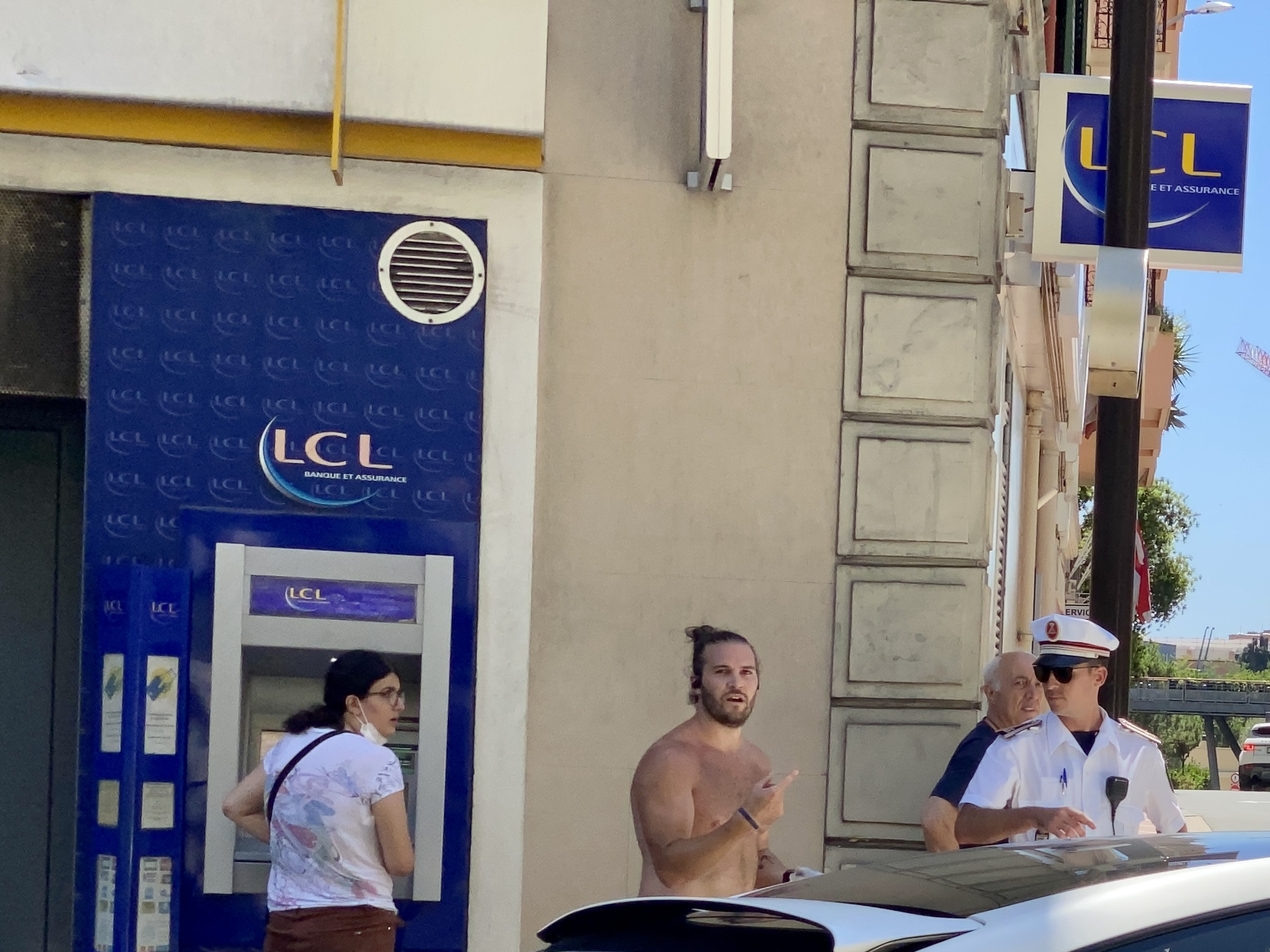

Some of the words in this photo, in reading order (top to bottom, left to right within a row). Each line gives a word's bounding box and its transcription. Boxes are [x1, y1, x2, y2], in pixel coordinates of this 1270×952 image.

[1160, 184, 1172, 192] ET
[1174, 185, 1240, 196] ASSURANCE
[274, 429, 392, 469] LCL
[304, 472, 341, 480] BANQUE
[355, 474, 407, 483] ASSURANCE
[289, 588, 327, 601] LCL
[1066, 608, 1090, 616] ERVIC
